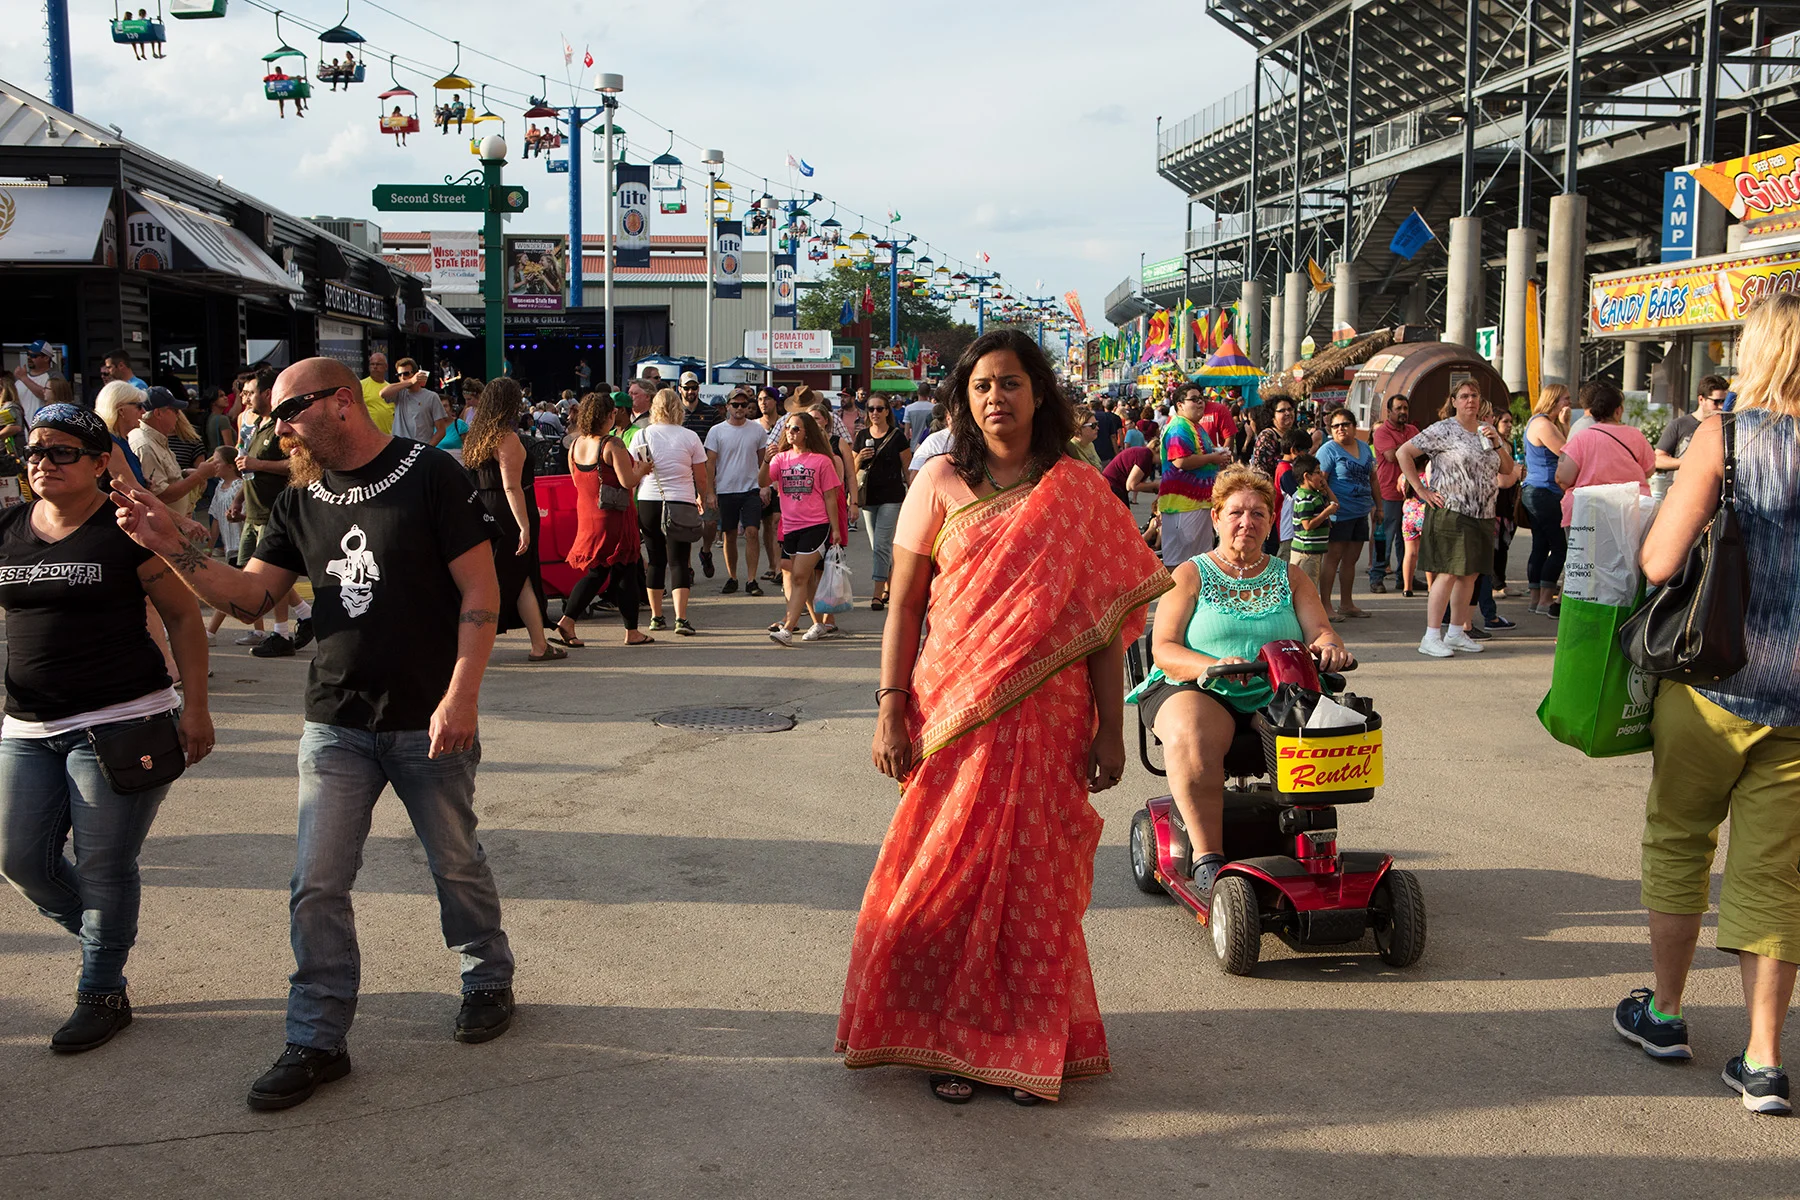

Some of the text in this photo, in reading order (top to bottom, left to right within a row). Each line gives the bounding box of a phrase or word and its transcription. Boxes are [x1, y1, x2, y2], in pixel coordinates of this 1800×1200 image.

[390, 193, 466, 204] Second Street
[620, 190, 647, 209] Lite
[1670, 176, 1688, 244] RAMP
[129, 222, 168, 247] Lite
[433, 246, 479, 257] WISCONSIN
[719, 240, 740, 254] Lite
[435, 257, 479, 269] STATE FAIR
[776, 270, 793, 282] Lite
[325, 283, 384, 320] SPORTS BAR AND GRILL
[1599, 283, 1689, 327] CANDY BARS
[762, 332, 815, 341] INFORMATION
[774, 341, 803, 350] CENTER
[745, 372, 758, 382] Lite
[345, 443, 426, 505] Milwaukee
[0, 565, 97, 581] ESEL POWER
[1625, 703, 1651, 718] AND
[1616, 722, 1646, 738] piggly
[1279, 744, 1382, 759] Scooter
[1290, 754, 1372, 790] Rental
